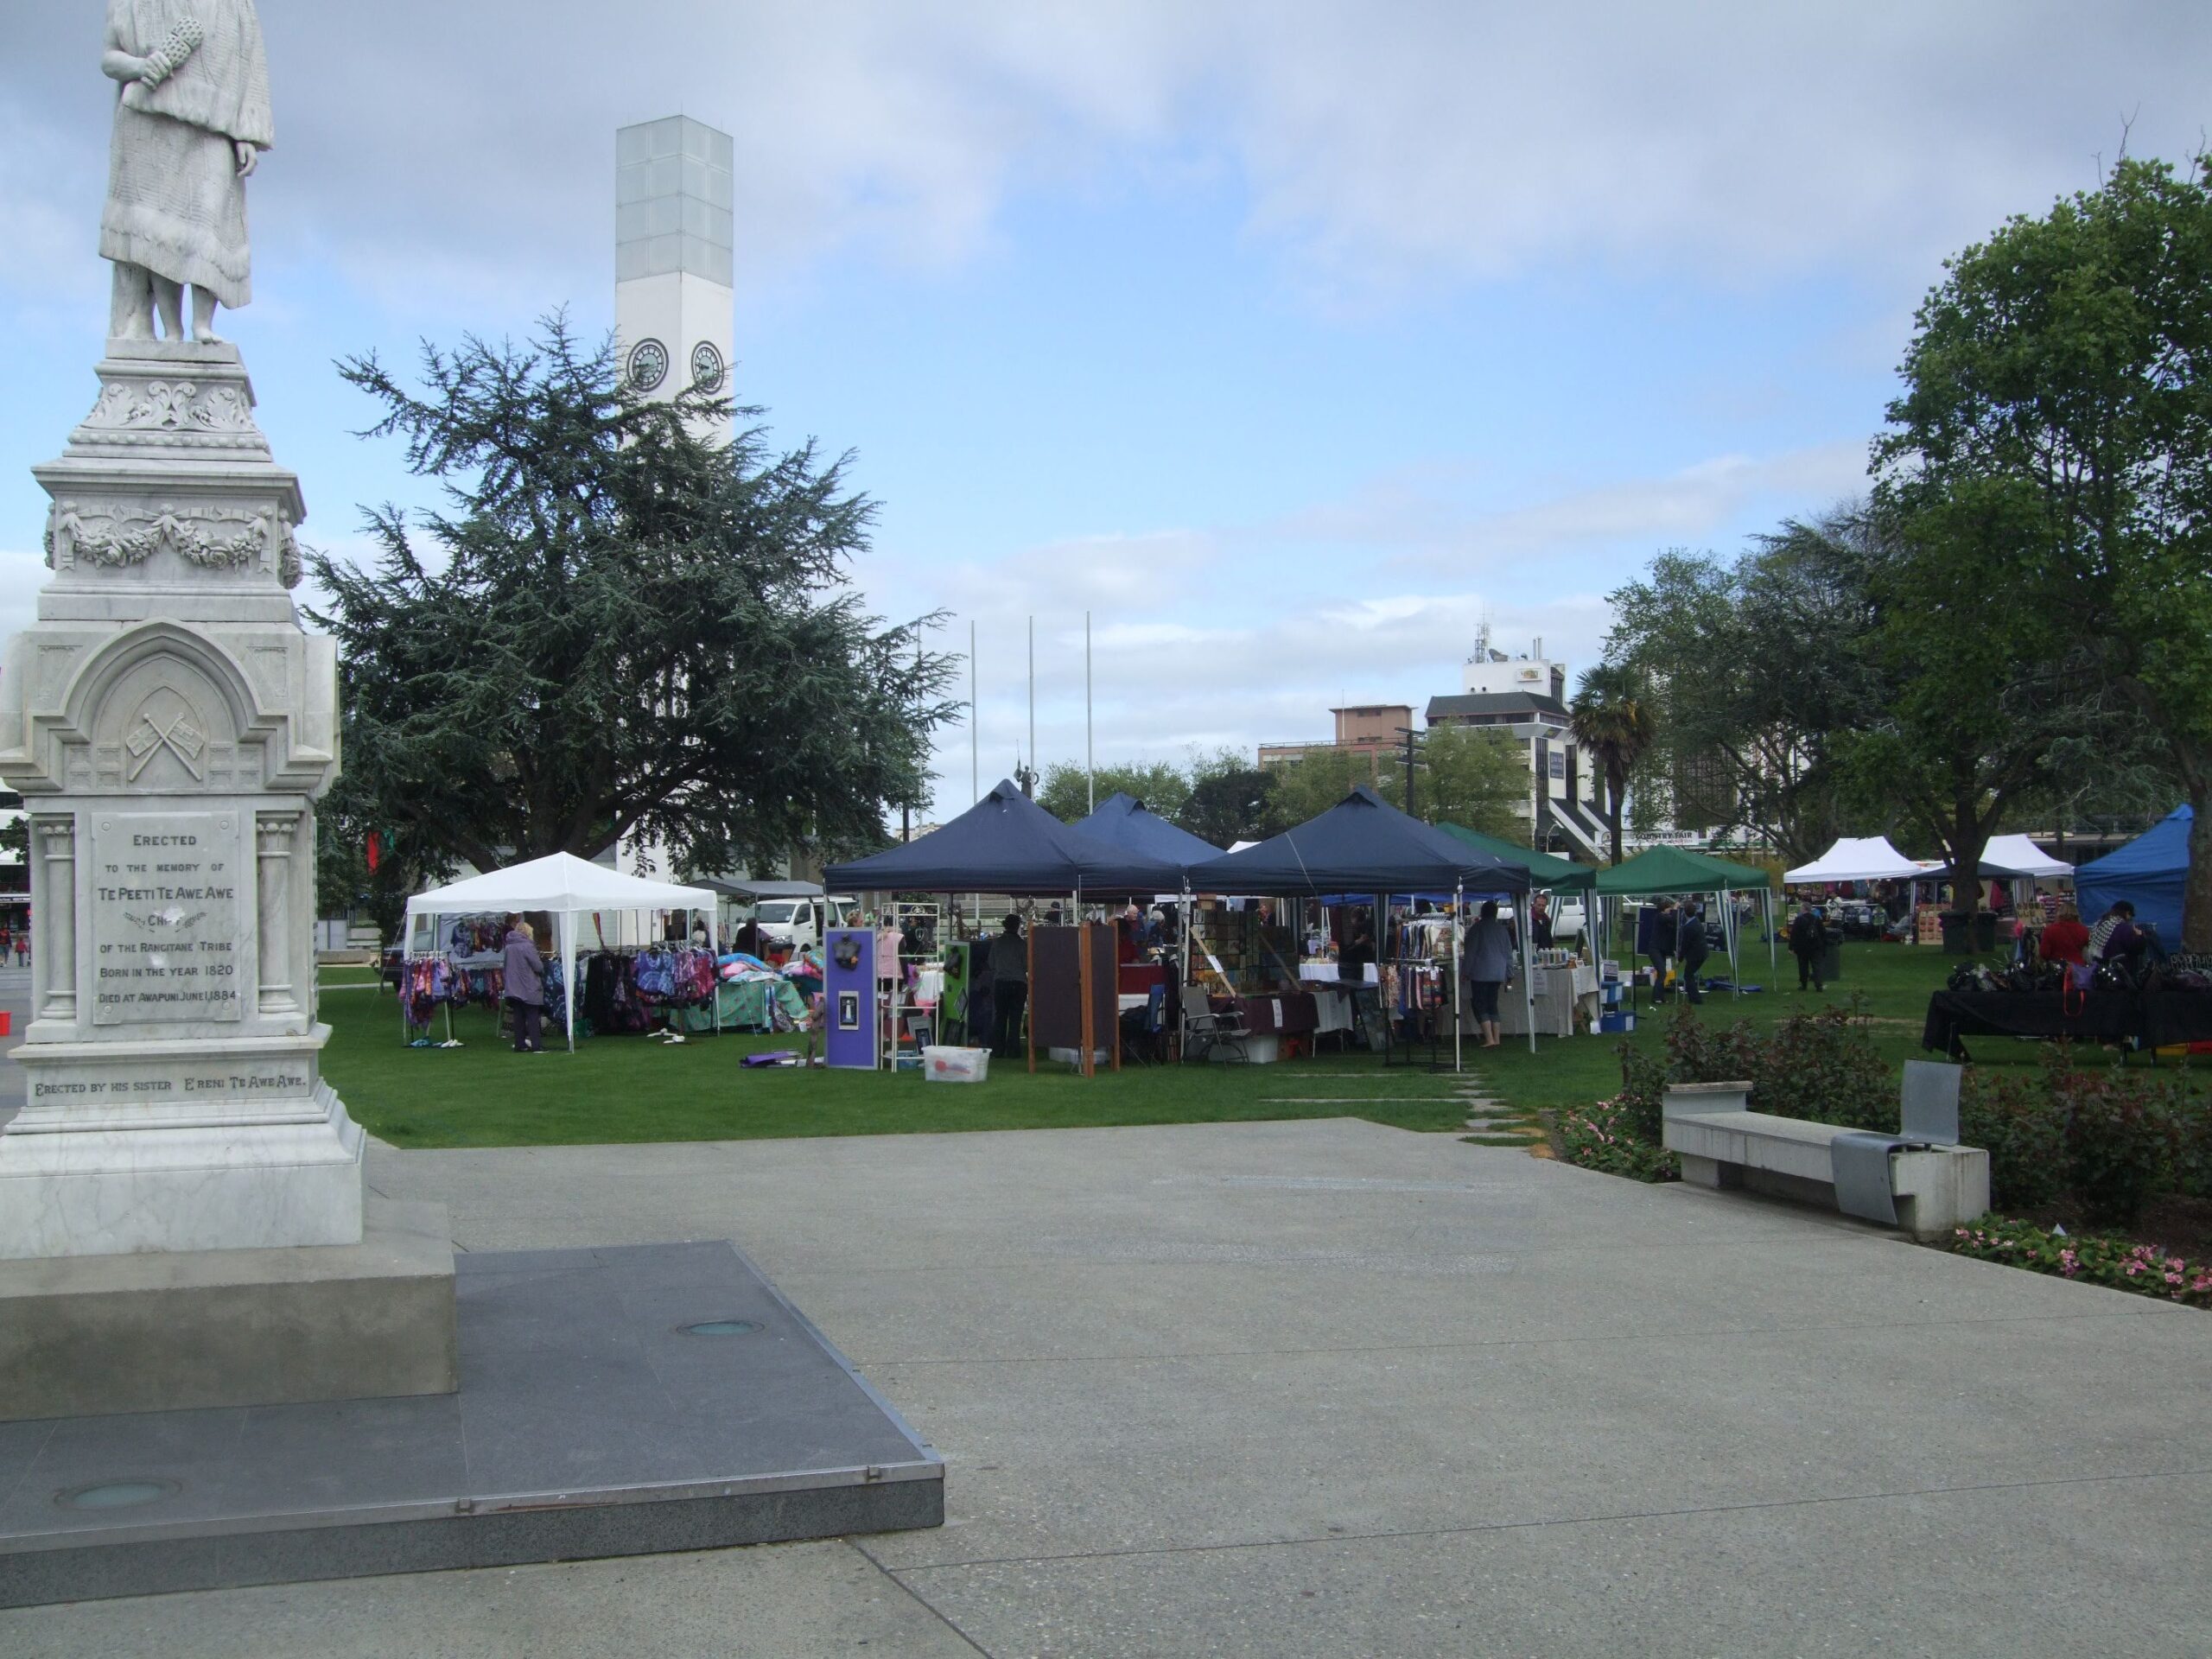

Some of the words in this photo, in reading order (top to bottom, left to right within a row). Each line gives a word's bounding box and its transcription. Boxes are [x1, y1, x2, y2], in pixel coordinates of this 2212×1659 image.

[134, 835, 196, 846] ERECTED
[105, 864, 118, 873] TO
[126, 864, 147, 873] THE
[99, 887, 116, 900] TE
[118, 887, 154, 900] PEETI
[156, 887, 173, 899] TE
[175, 887, 202, 899] AWE
[205, 887, 233, 899] AWE
[100, 944, 112, 954] OF
[200, 942, 232, 951] TRIBE
[100, 968, 128, 978] BORN
[132, 968, 142, 977] IN
[145, 968, 165, 976] THE
[169, 968, 199, 976] YEAR
[206, 964, 233, 976] 1820
[99, 994, 120, 1003] DIED
[123, 994, 135, 1002] AT
[179, 992, 204, 1002] JUNE
[35, 1083, 86, 1096] ERECTED
[91, 1084, 106, 1092] BY
[111, 1082, 129, 1092] HIS
[133, 1081, 171, 1091] SISTER
[230, 1077, 245, 1089] TE
[248, 1076, 275, 1089] AWE
